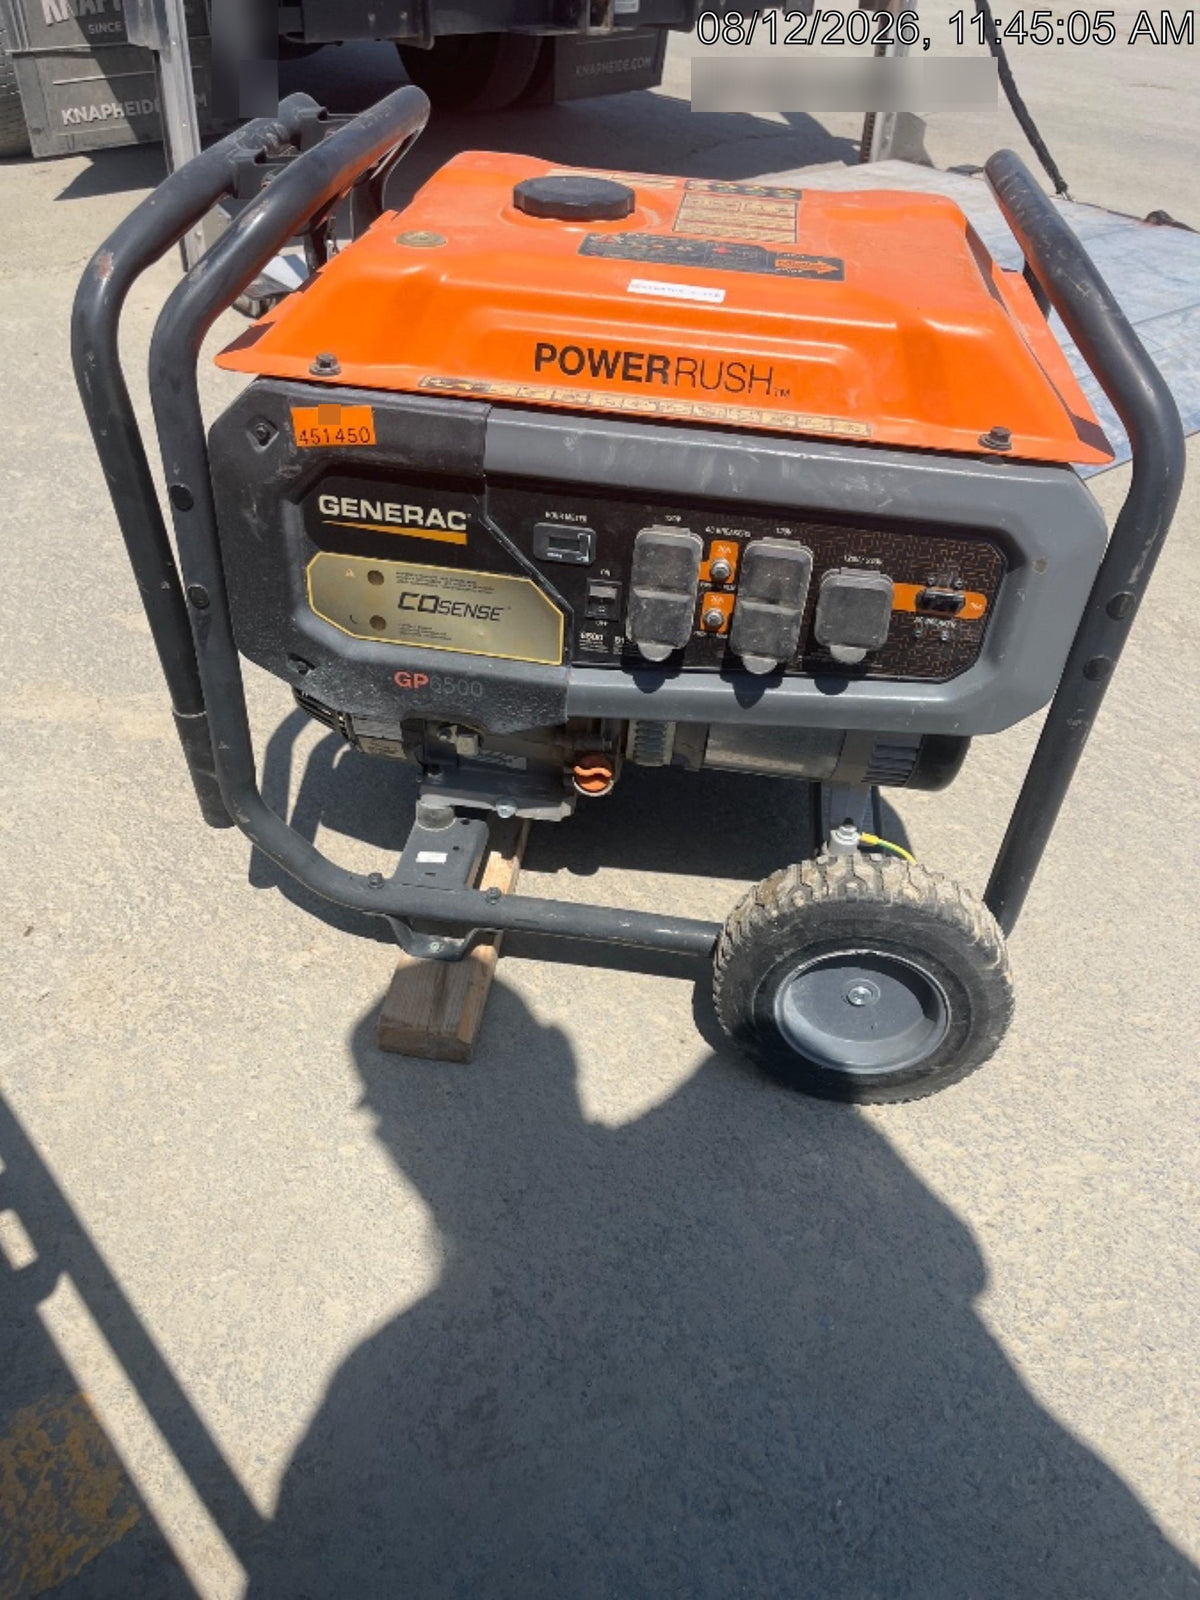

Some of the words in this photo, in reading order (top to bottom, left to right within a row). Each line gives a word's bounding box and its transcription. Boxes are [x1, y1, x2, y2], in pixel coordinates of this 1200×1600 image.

[87, 21, 123, 35] SINCE
[299, 426, 371, 445] 451450
[318, 494, 467, 531] GENERAC
[398, 591, 505, 622] COSENSE
